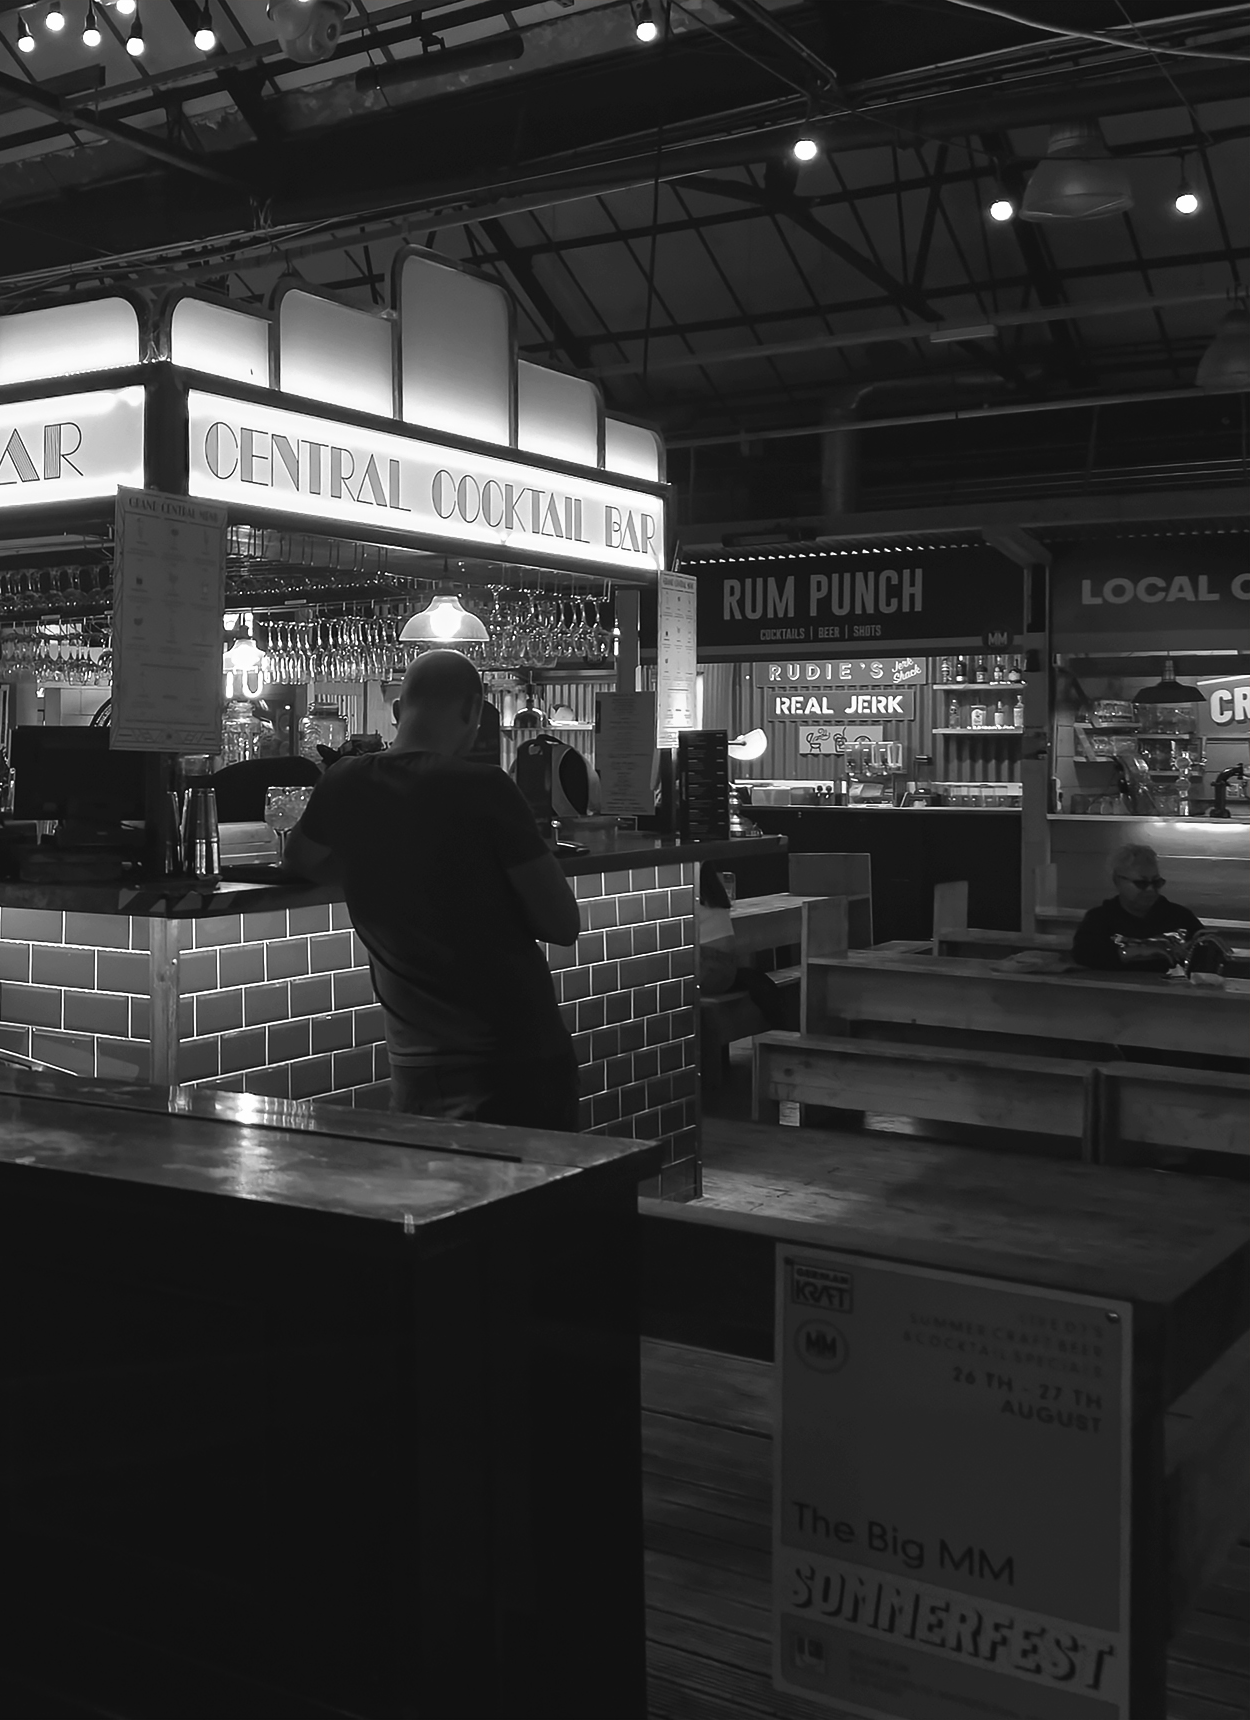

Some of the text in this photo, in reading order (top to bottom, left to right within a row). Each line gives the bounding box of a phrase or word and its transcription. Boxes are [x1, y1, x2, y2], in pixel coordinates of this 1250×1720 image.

[204, 421, 657, 556] CENTRAL COCKTAIL BAR
[723, 568, 923, 620] RUM PUNCH
[1081, 575, 1220, 605] LOCAL
[760, 625, 882, 641] COCKTAILS BEER SHOTS
[988, 631, 1008, 646] MM
[768, 661, 884, 681] RUDIE'S
[891, 657, 914, 673] Jerk
[892, 664, 922, 684] Shack
[775, 695, 904, 715] REAL JERK
[1210, 686, 1250, 723] CR
[795, 1279, 850, 1308] KRAFT
[805, 1330, 837, 1360] MM
[952, 1366, 976, 1385] 26
[986, 1372, 1013, 1392] TH
[1039, 1383, 1062, 1401] 27
[1073, 1389, 1102, 1410] TH
[1000, 1399, 1102, 1434] AUGUST
[792, 1501, 1014, 1587] The Big MM
